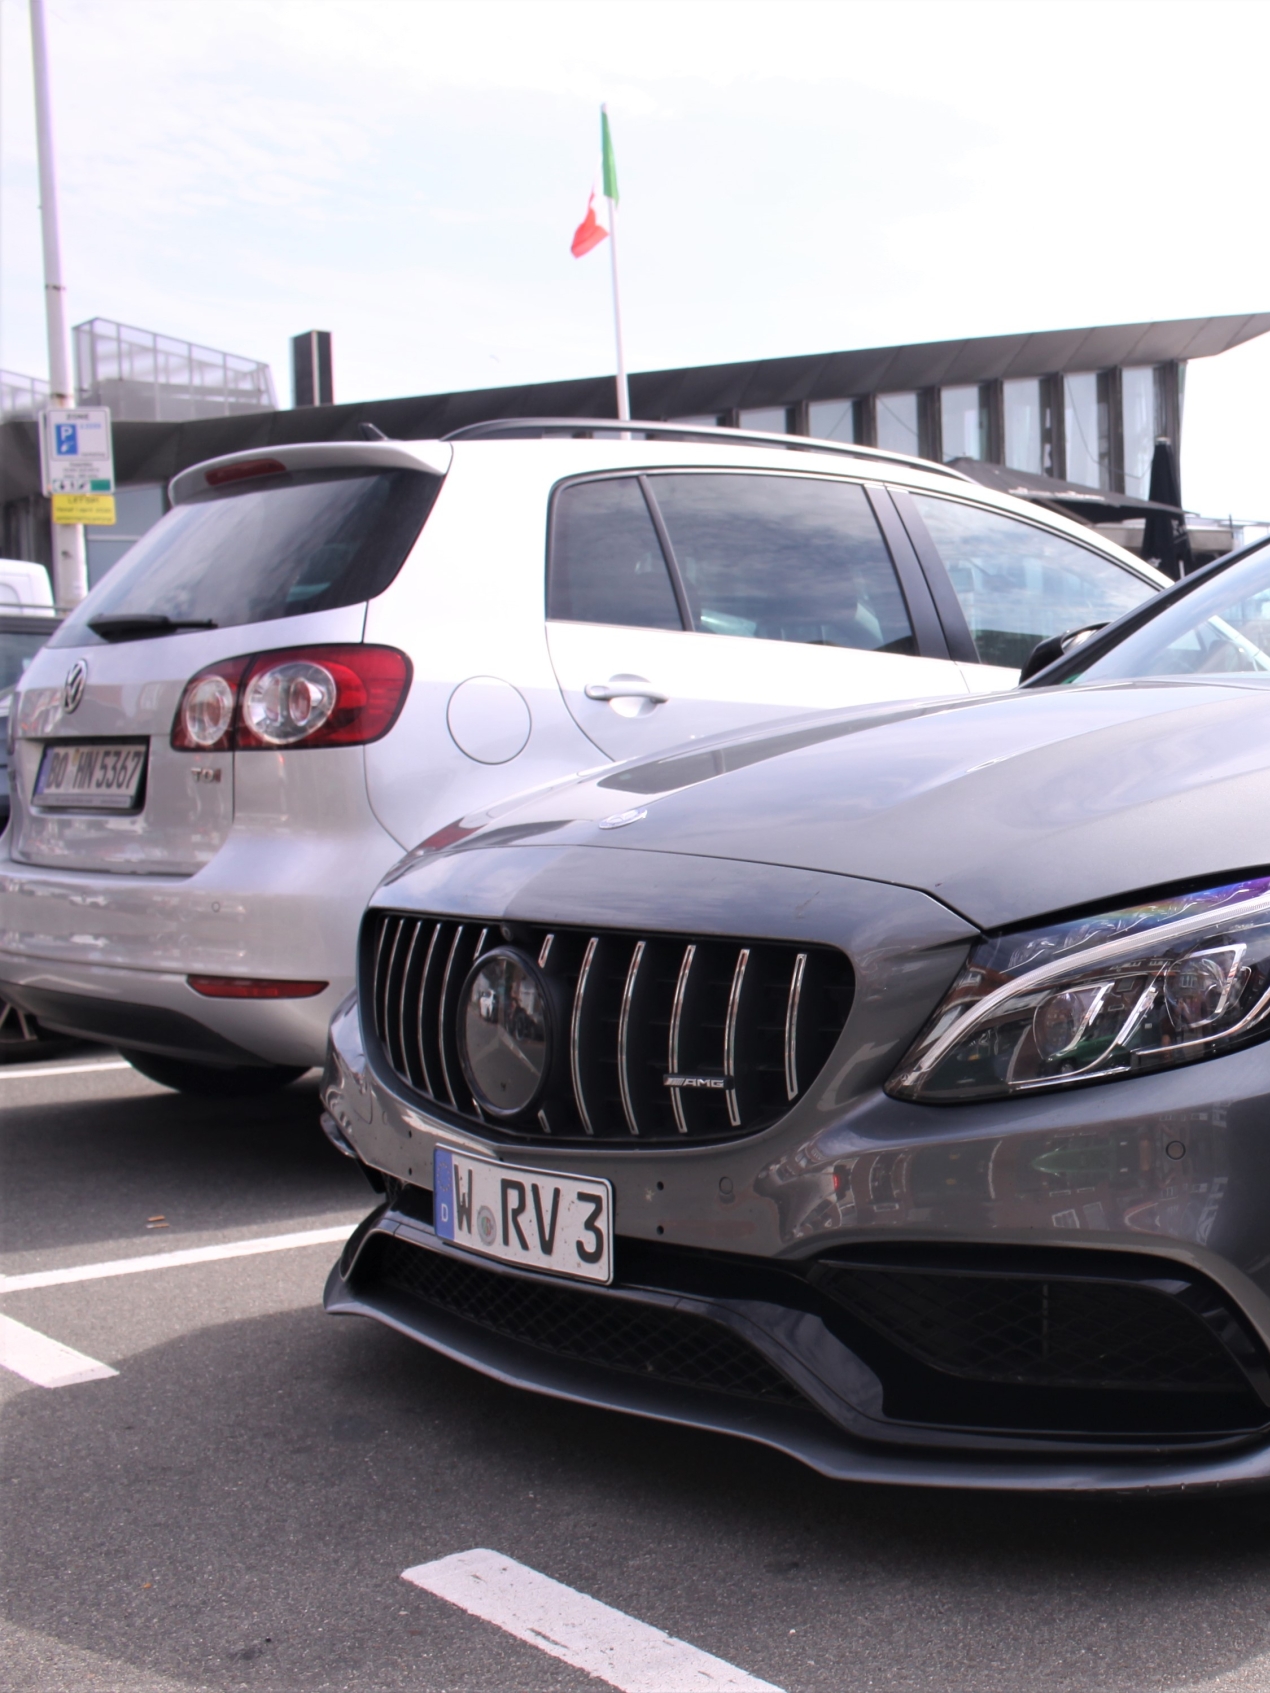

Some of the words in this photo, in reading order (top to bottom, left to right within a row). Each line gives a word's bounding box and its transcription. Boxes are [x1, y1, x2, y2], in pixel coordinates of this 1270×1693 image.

[95, 749, 145, 790] 5367
[682, 1078, 725, 1089] AMG
[441, 1203, 449, 1223] D
[453, 1163, 473, 1235] W
[500, 1177, 561, 1257] RV
[576, 1190, 604, 1265] 3
